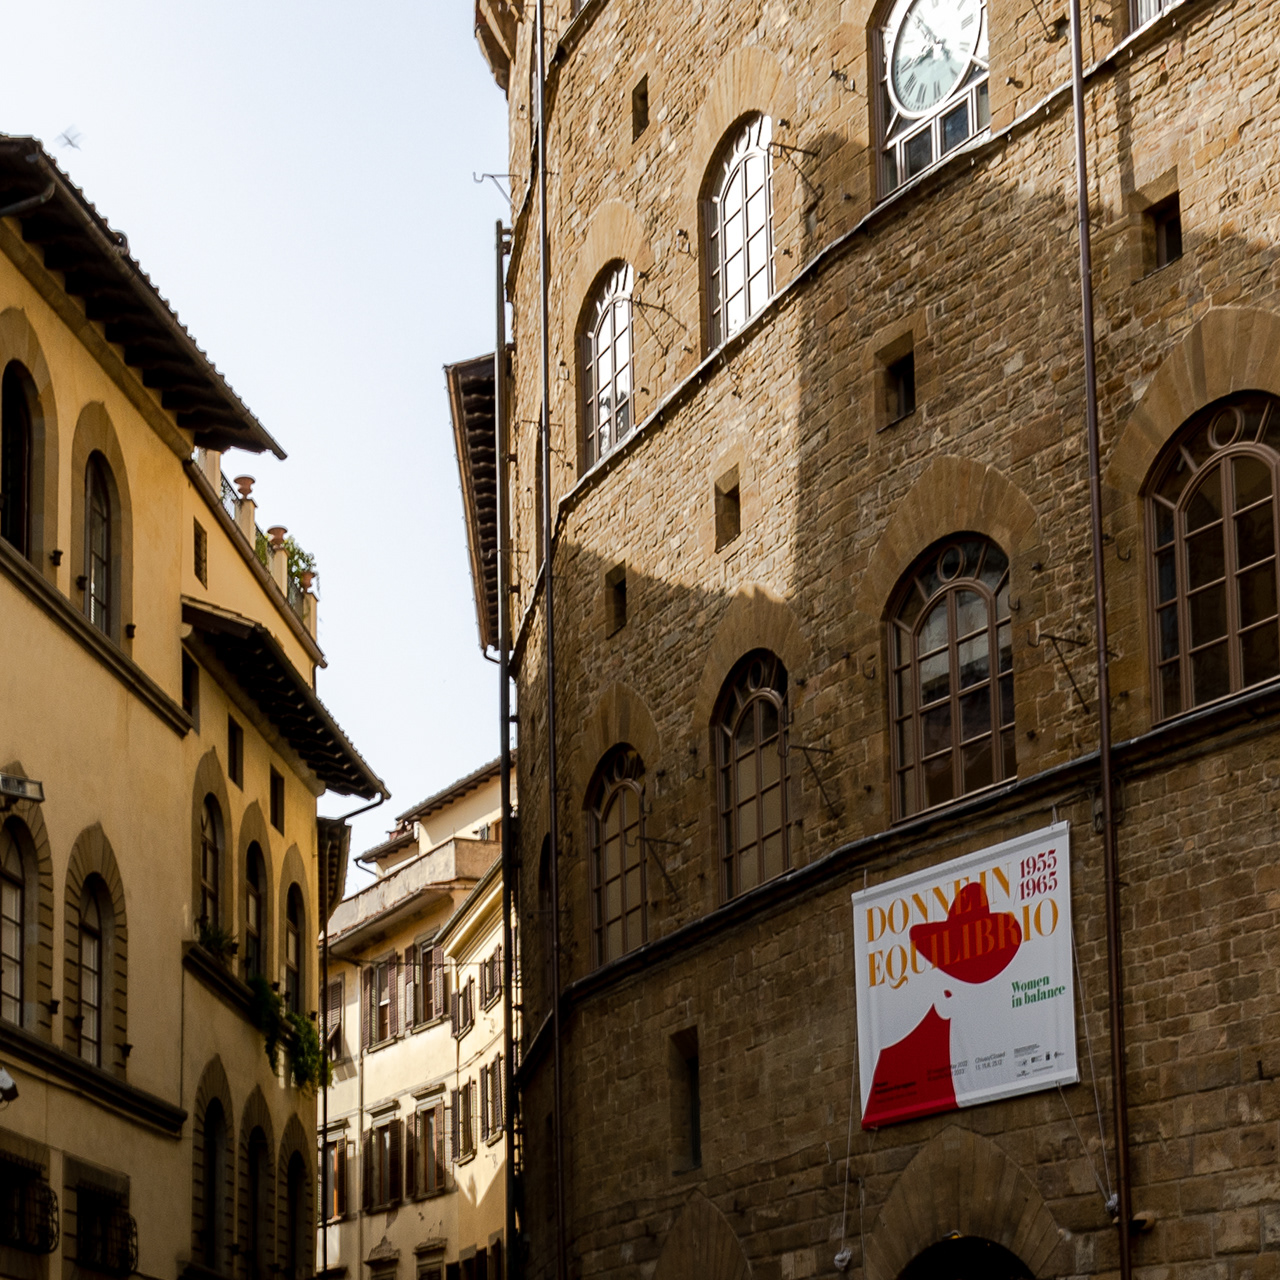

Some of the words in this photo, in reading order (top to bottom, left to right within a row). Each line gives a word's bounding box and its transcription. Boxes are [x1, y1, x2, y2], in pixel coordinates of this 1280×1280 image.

[1019, 849, 1057, 879] 1955
[1019, 870, 1058, 901] 1965
[865, 876, 972, 943] DONNE
[977, 861, 1013, 908] IN
[866, 897, 1059, 990] EQUILIBRIO
[1011, 976, 1050, 993] Women
[1011, 995, 1022, 1008] in
[1024, 985, 1066, 1005] balance
